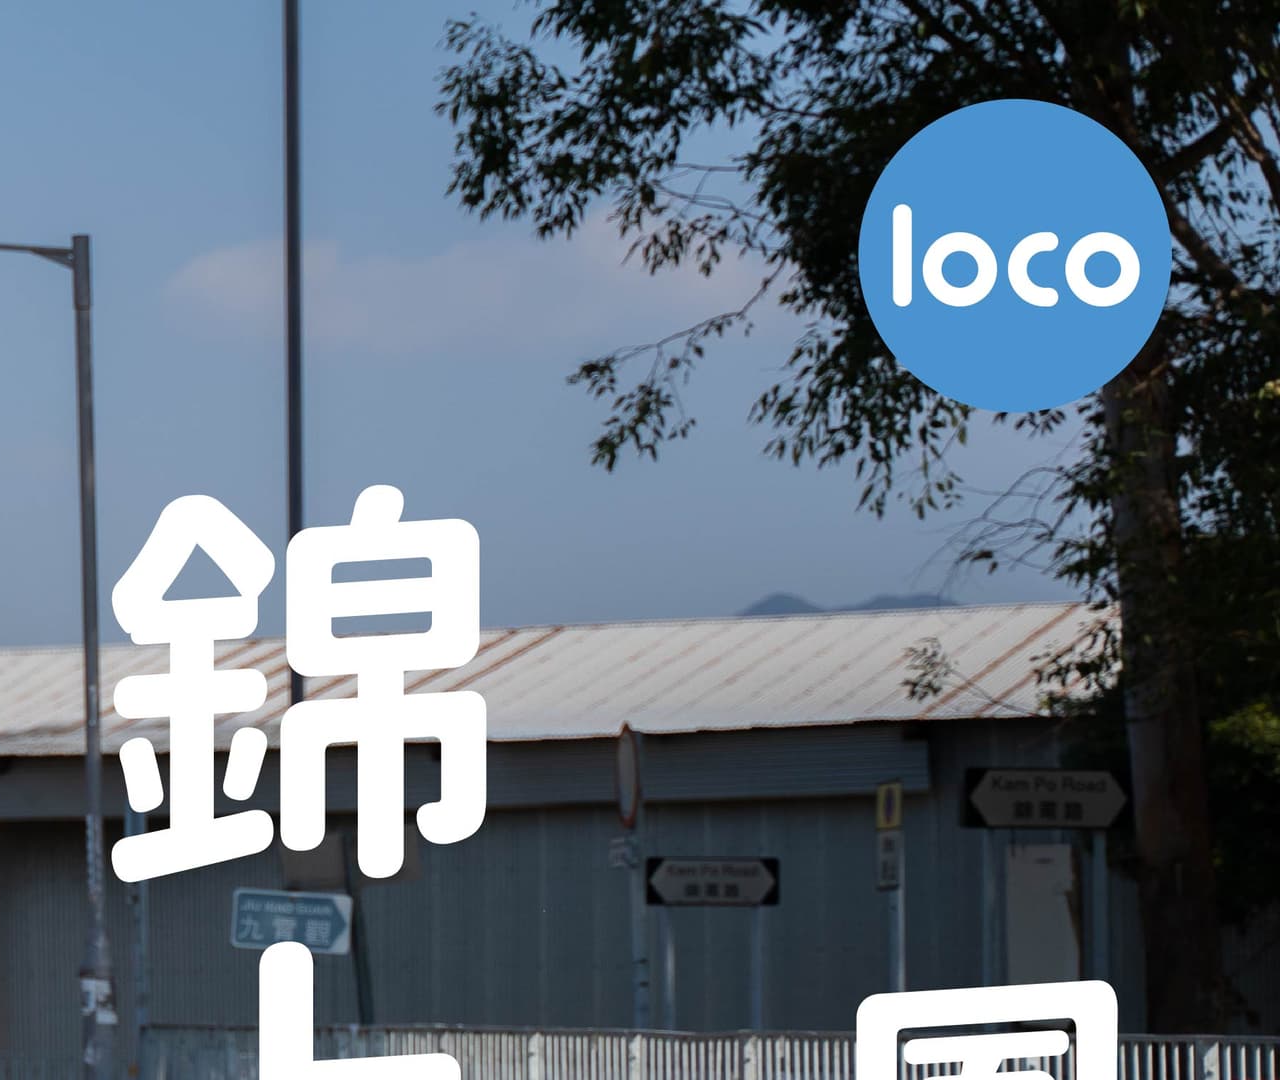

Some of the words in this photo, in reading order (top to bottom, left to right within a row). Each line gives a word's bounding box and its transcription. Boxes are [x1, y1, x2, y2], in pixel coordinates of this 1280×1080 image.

[991, 775, 1030, 792] Kam
[1034, 776, 1057, 793] Po
[1061, 776, 1107, 793] Road
